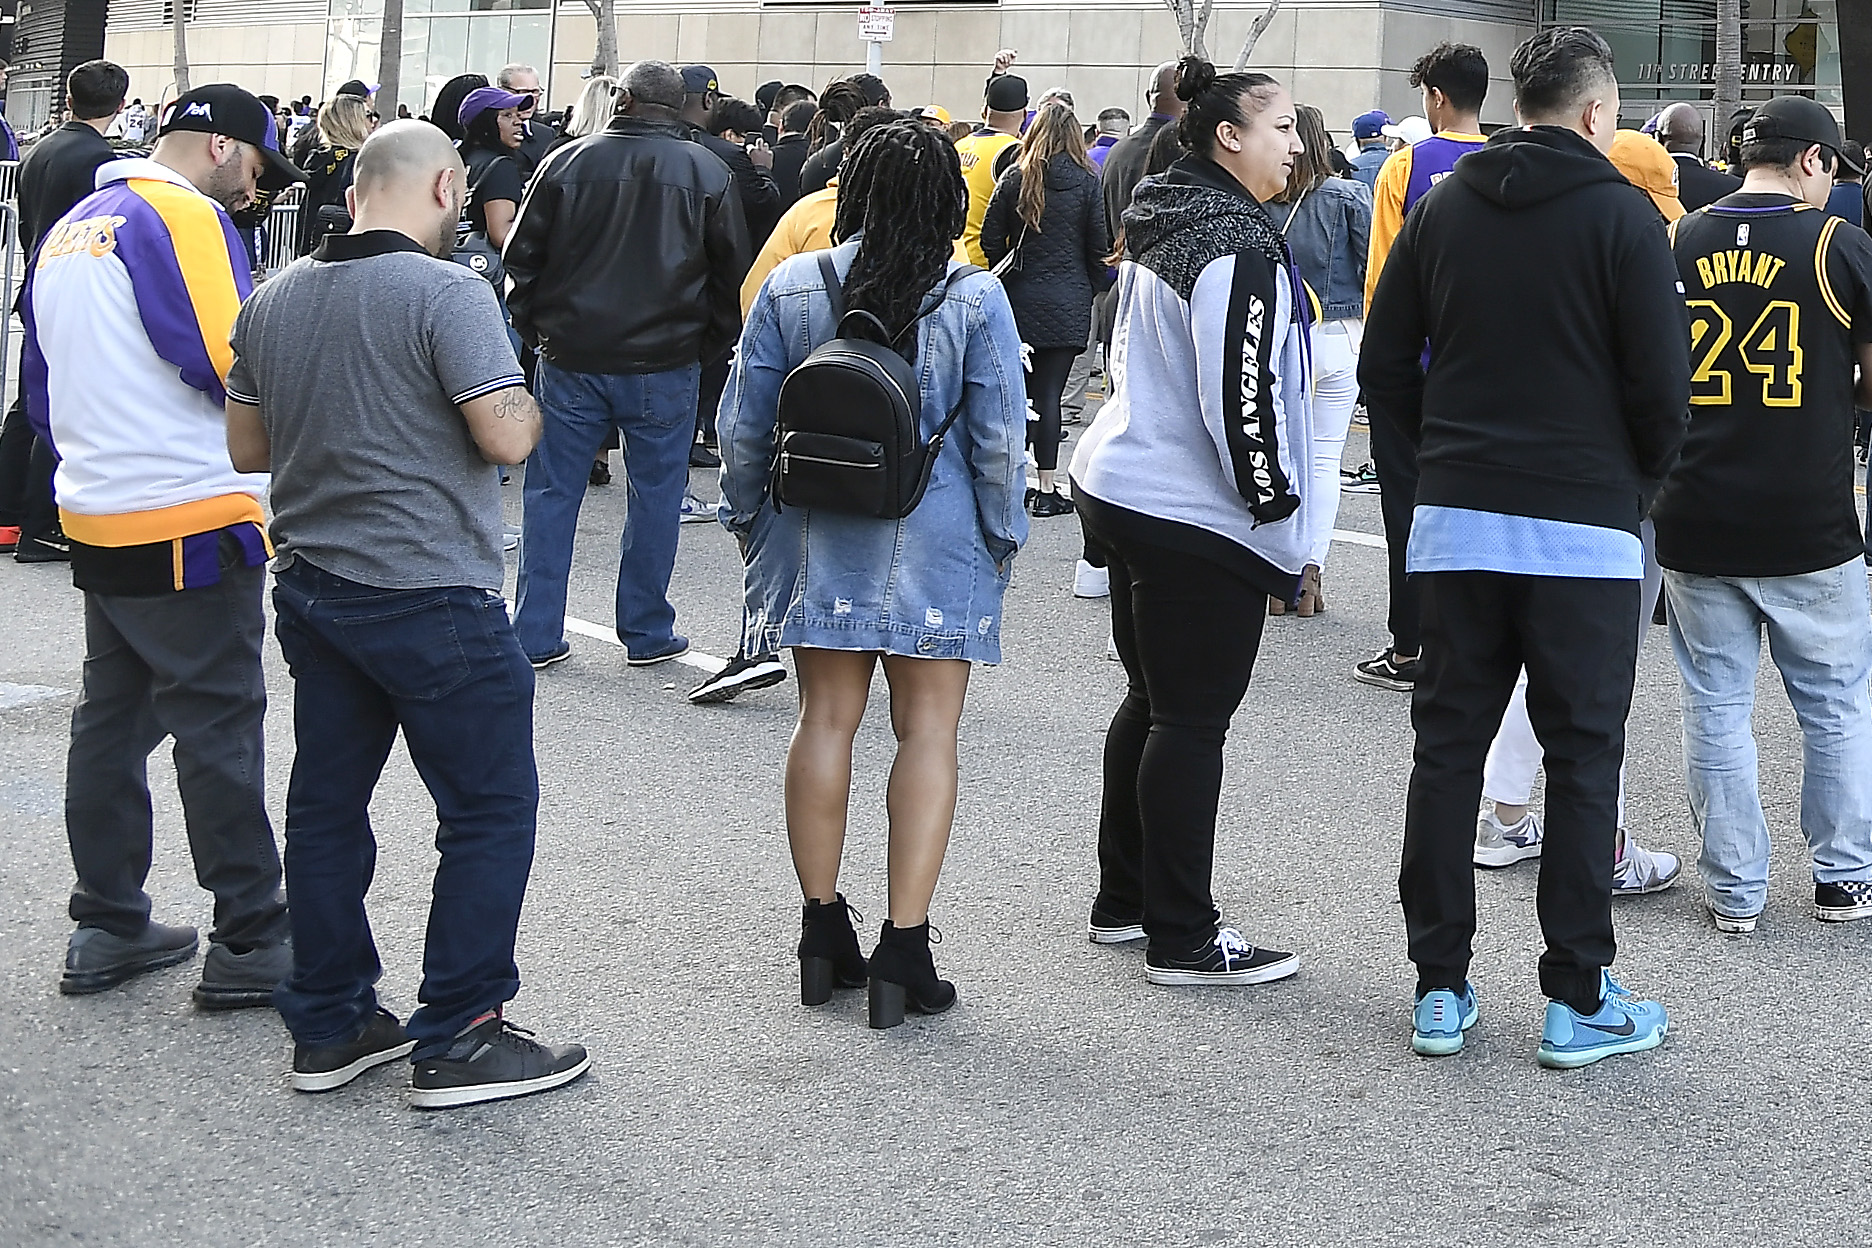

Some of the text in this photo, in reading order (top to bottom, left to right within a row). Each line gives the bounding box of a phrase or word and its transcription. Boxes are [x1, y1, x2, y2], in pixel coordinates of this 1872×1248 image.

[1669, 63, 1717, 80] STREE
[129, 119, 143, 129] 24
[1695, 249, 1786, 290] BRYANT
[1685, 299, 1804, 408] 24
[1240, 294, 1276, 506] LOS ANGELES
